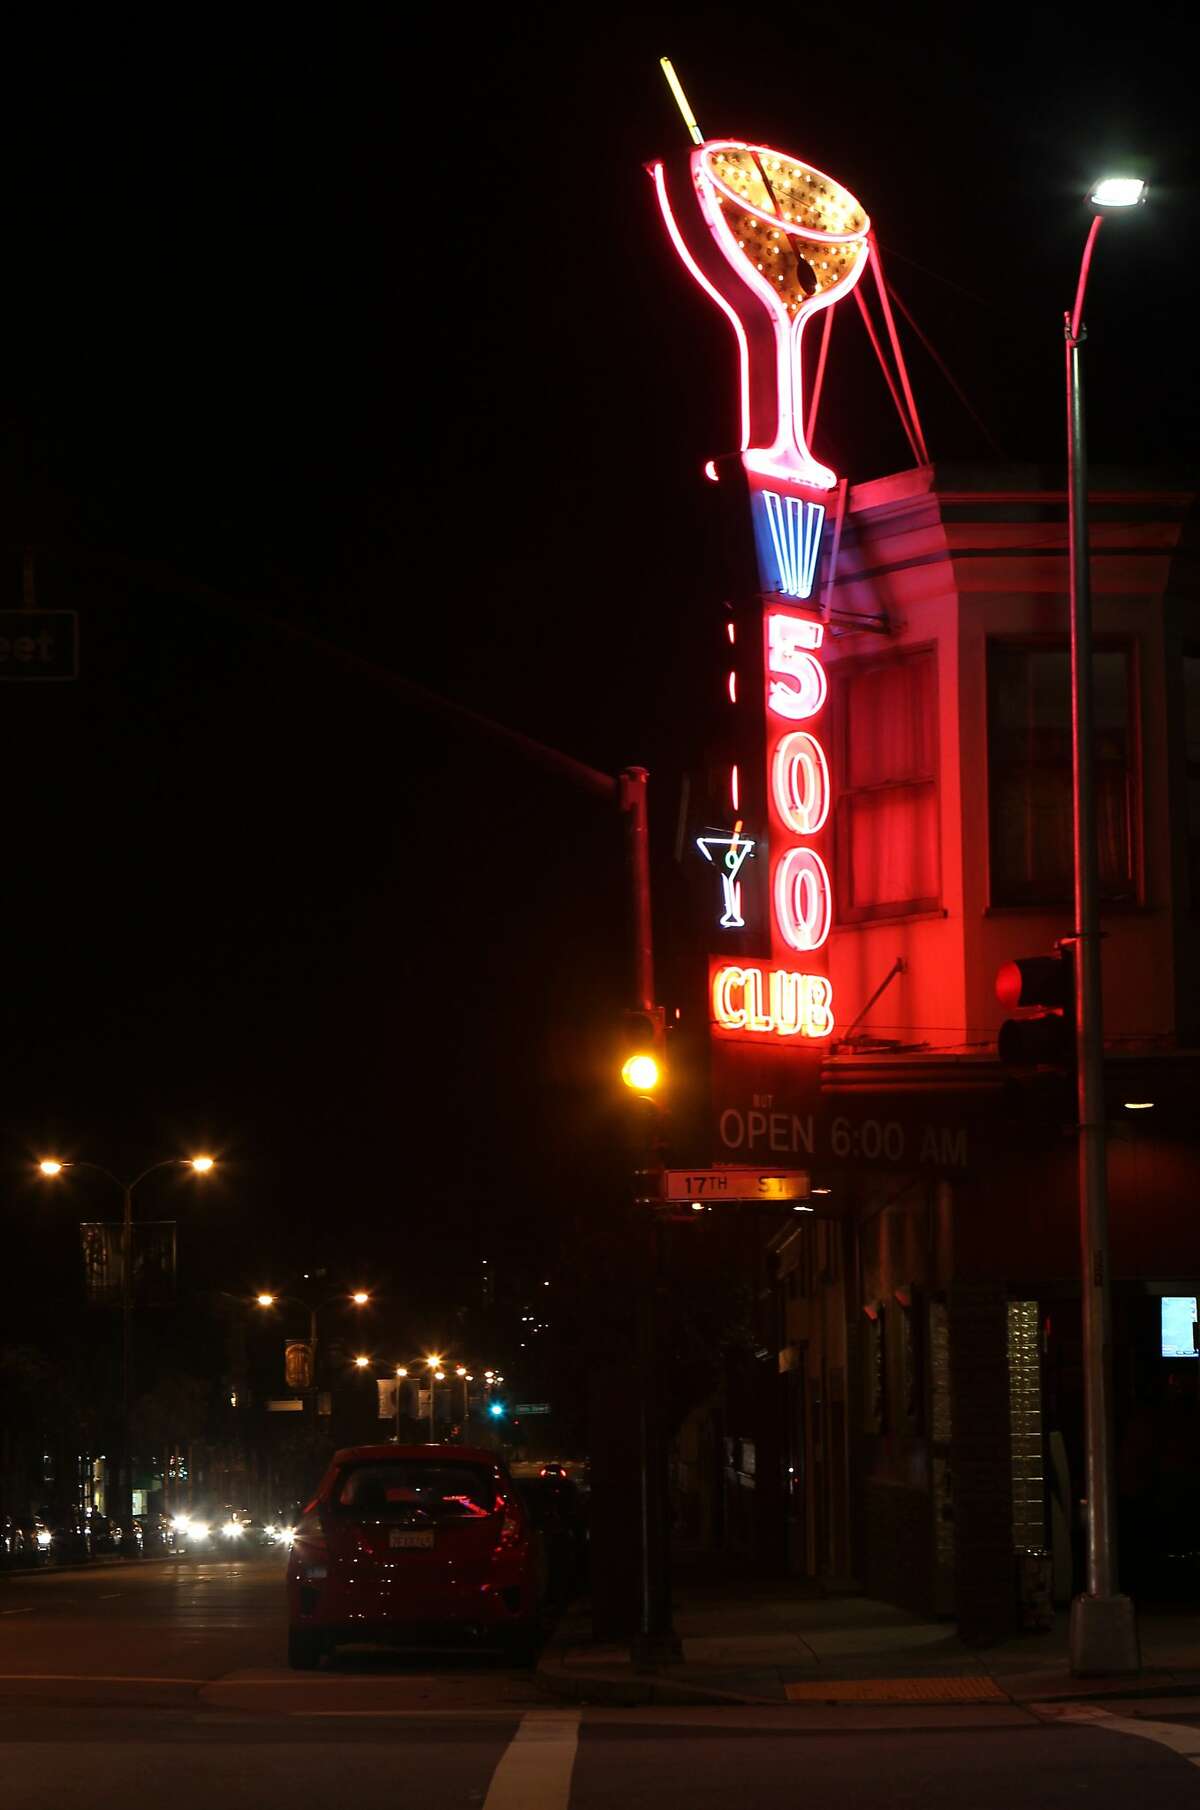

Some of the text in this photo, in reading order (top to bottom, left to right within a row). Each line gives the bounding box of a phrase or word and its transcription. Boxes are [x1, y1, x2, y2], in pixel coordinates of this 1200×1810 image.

[768, 613, 831, 953] 500
[712, 966, 833, 1037] CLUB
[719, 1108, 968, 1168] OPEN 6:00 AM
[685, 1176, 787, 1194] 17TH ST
